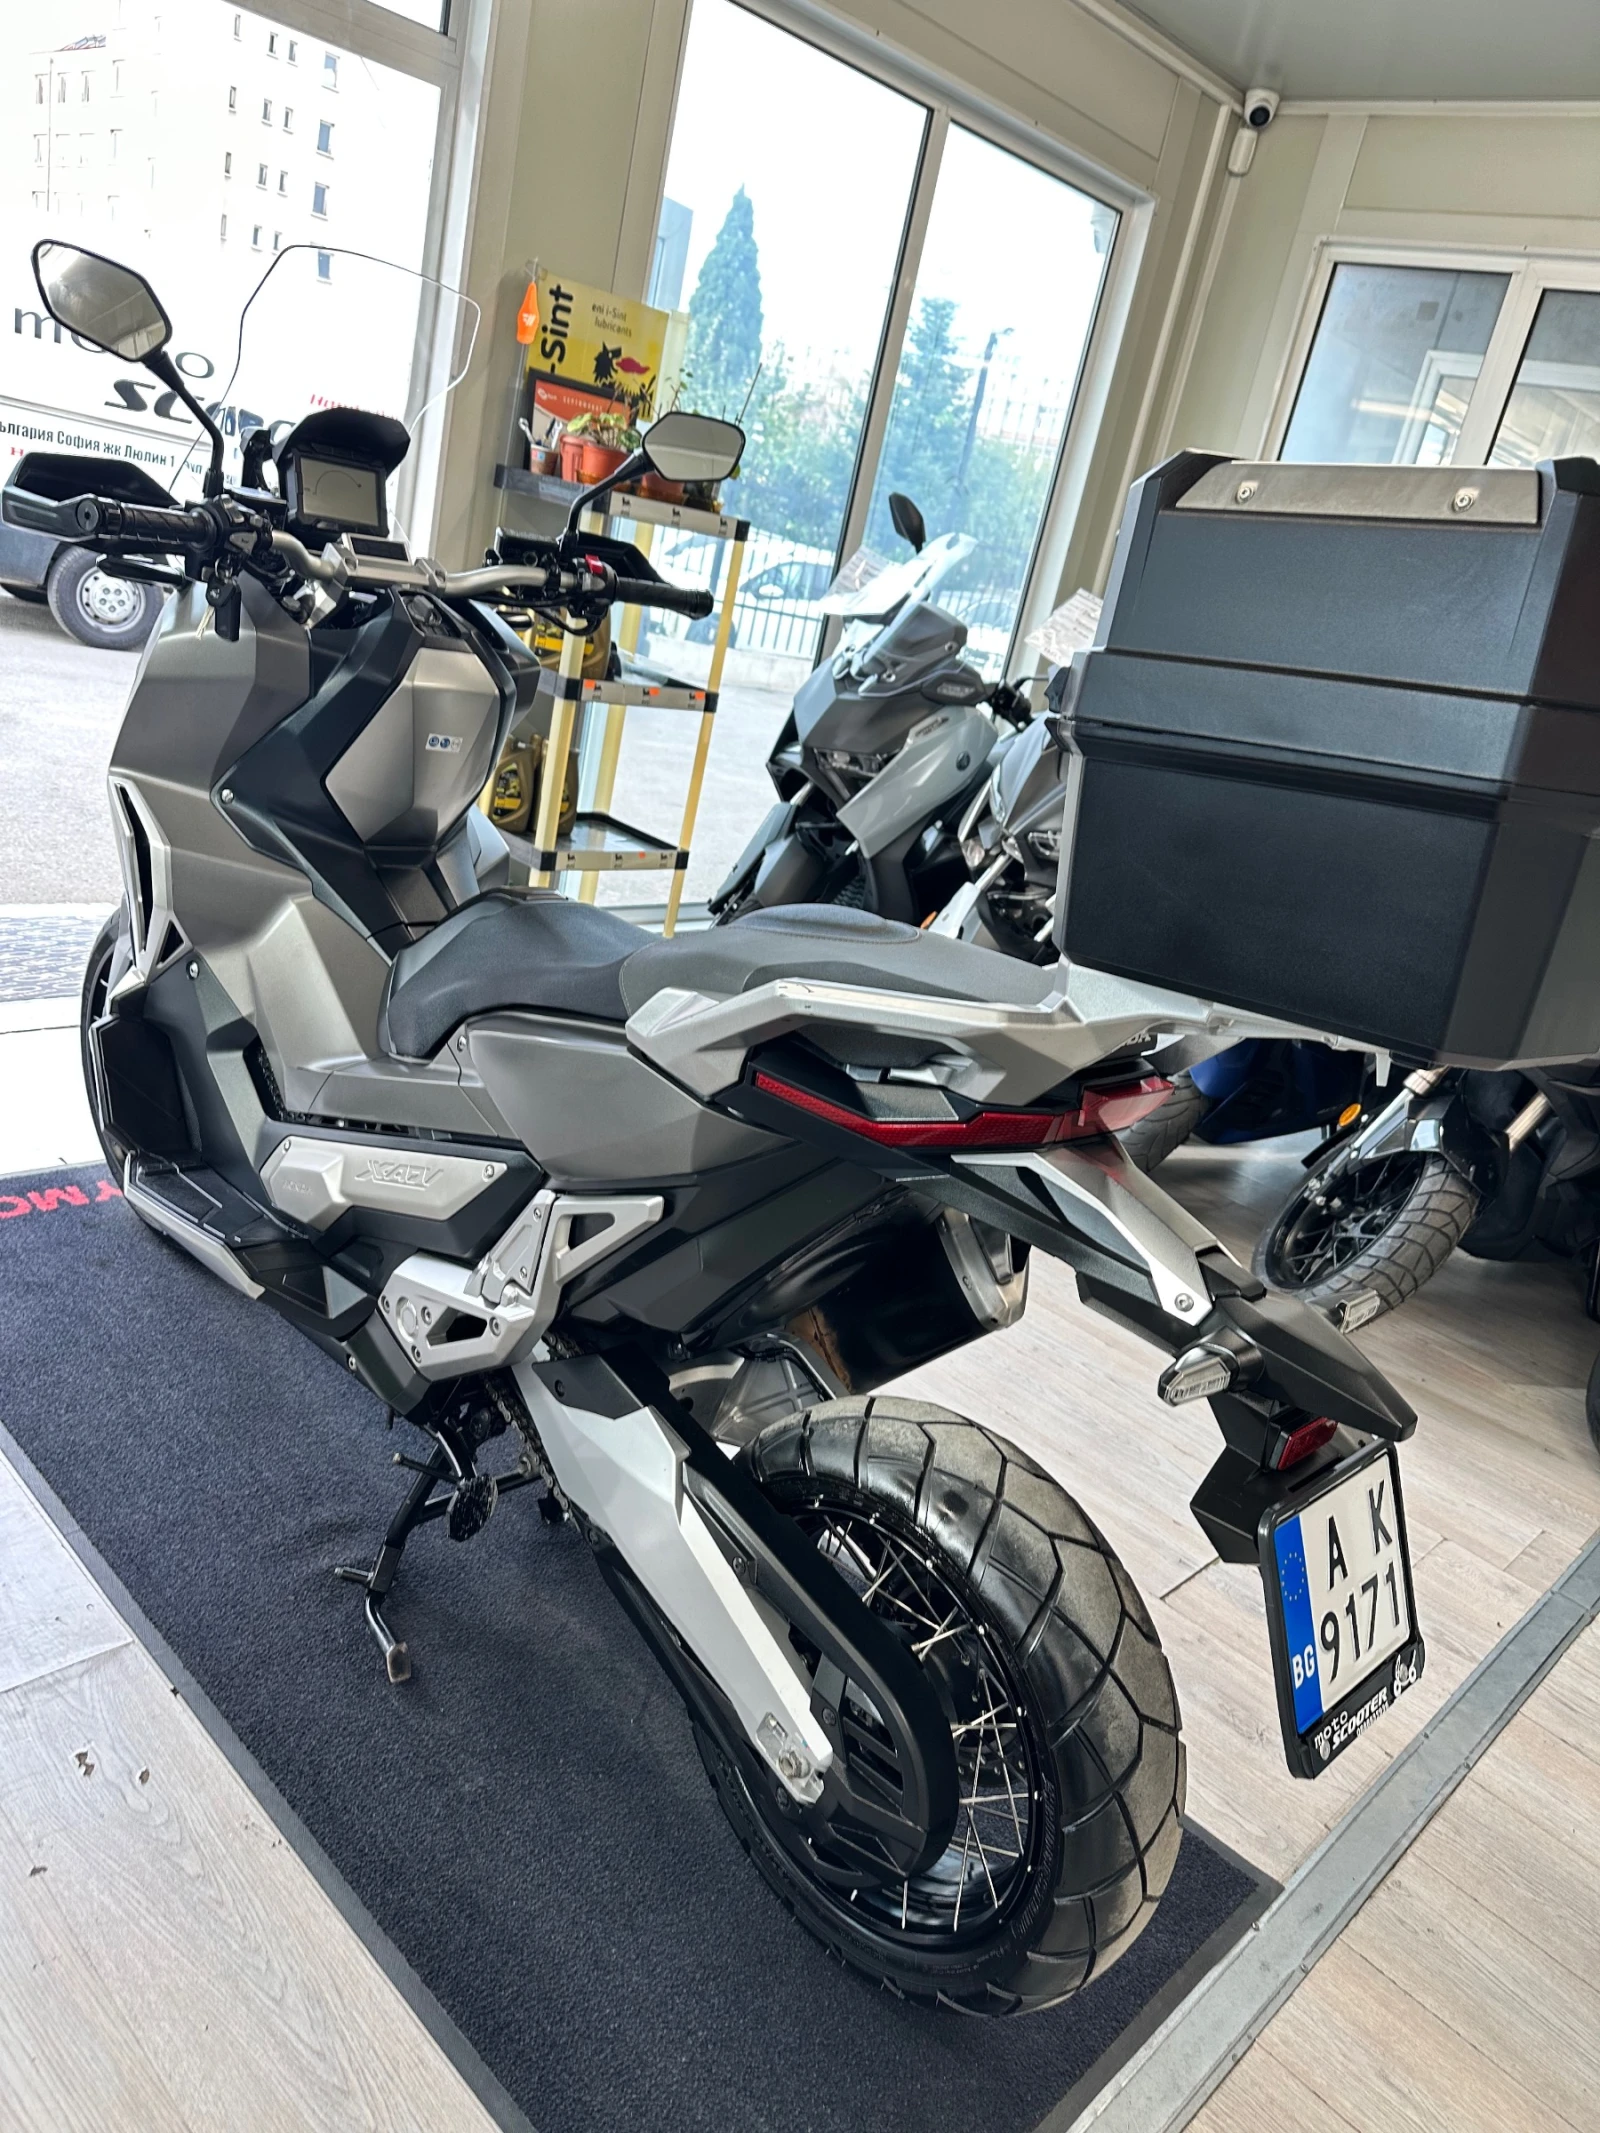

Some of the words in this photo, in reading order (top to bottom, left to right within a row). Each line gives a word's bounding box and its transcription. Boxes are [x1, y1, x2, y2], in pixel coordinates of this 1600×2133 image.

[594, 317, 632, 338] lubricants
[56, 430, 101, 451] София
[103, 442, 121, 456] жк
[1320, 1561, 1400, 1685] 9171
[1292, 1644, 1317, 1690] BG
[1314, 1710, 1348, 1750] moto
[1332, 1686, 1387, 1750] SCOOTER
